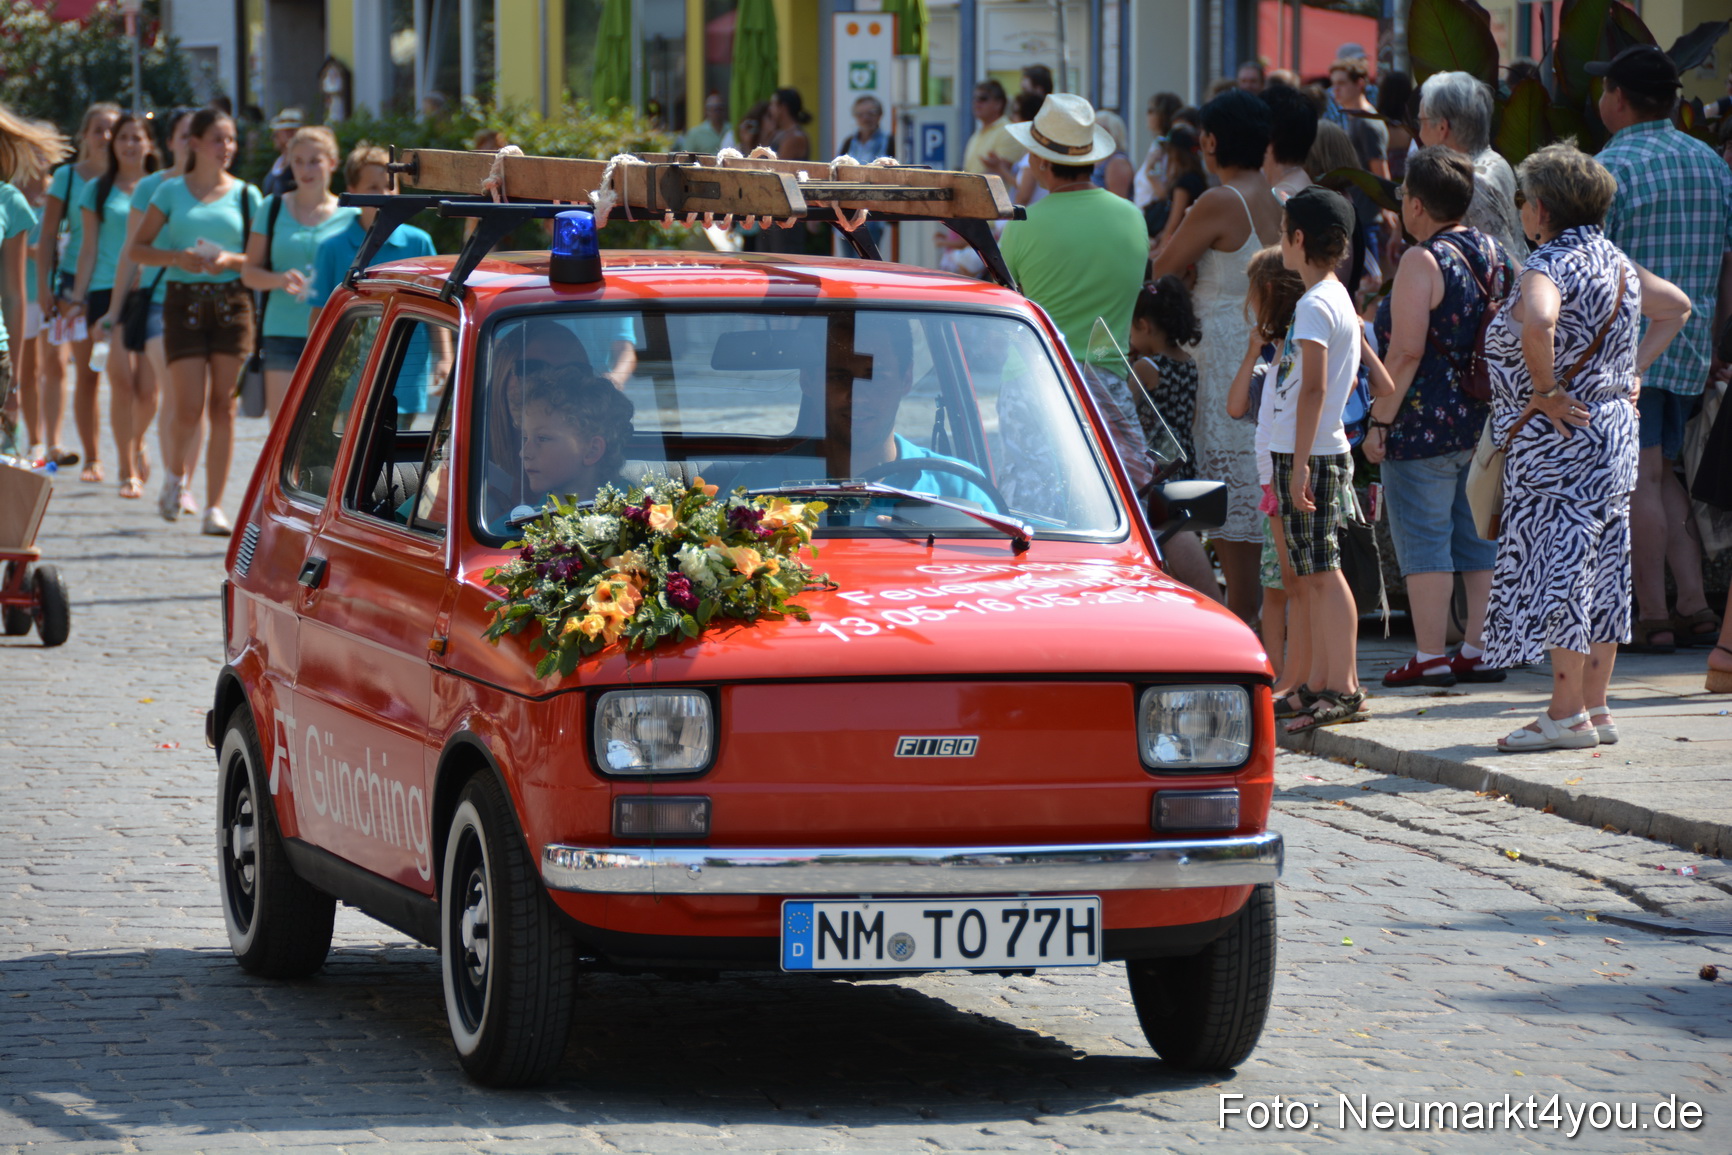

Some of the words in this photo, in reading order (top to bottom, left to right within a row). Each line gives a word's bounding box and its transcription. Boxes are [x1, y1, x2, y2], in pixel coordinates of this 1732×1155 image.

[926, 129, 943, 157] P
[915, 563, 1138, 577] Günchi
[899, 739, 974, 755] FIGO
[305, 724, 431, 881] Günching
[818, 910, 884, 960] NM
[923, 908, 987, 959] TO
[1002, 907, 1096, 957] 77H
[792, 943, 804, 957] D
